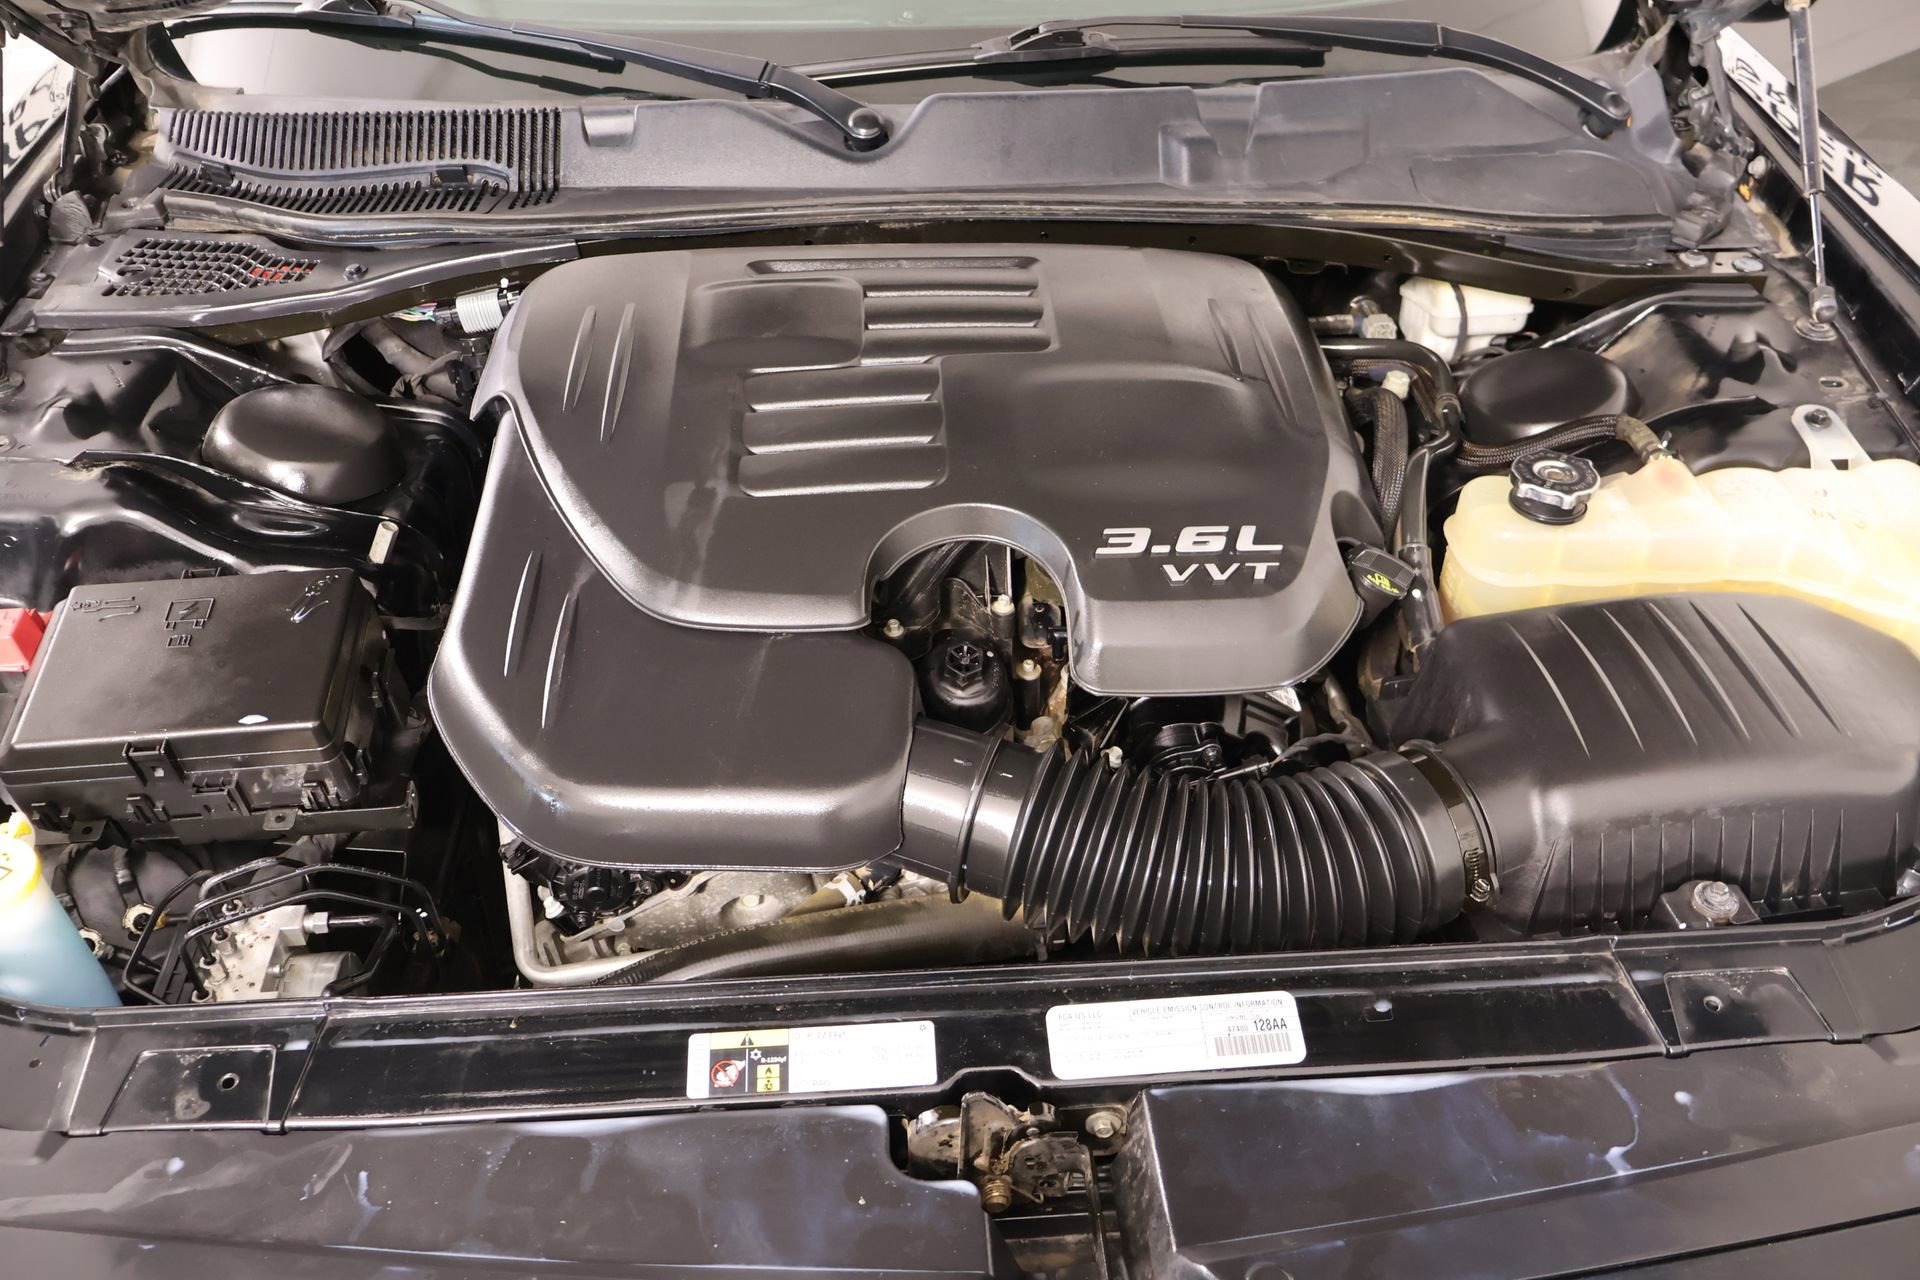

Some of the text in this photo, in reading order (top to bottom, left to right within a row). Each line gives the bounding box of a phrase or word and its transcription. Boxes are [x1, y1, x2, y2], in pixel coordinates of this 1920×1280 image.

[1095, 525, 1283, 557] 3.6L
[1161, 562, 1280, 585] VVT
[1131, 999, 1283, 1017] VEHICLE EMISSION CONTROL INFORMATION
[1253, 1017, 1288, 1032] 128AA
